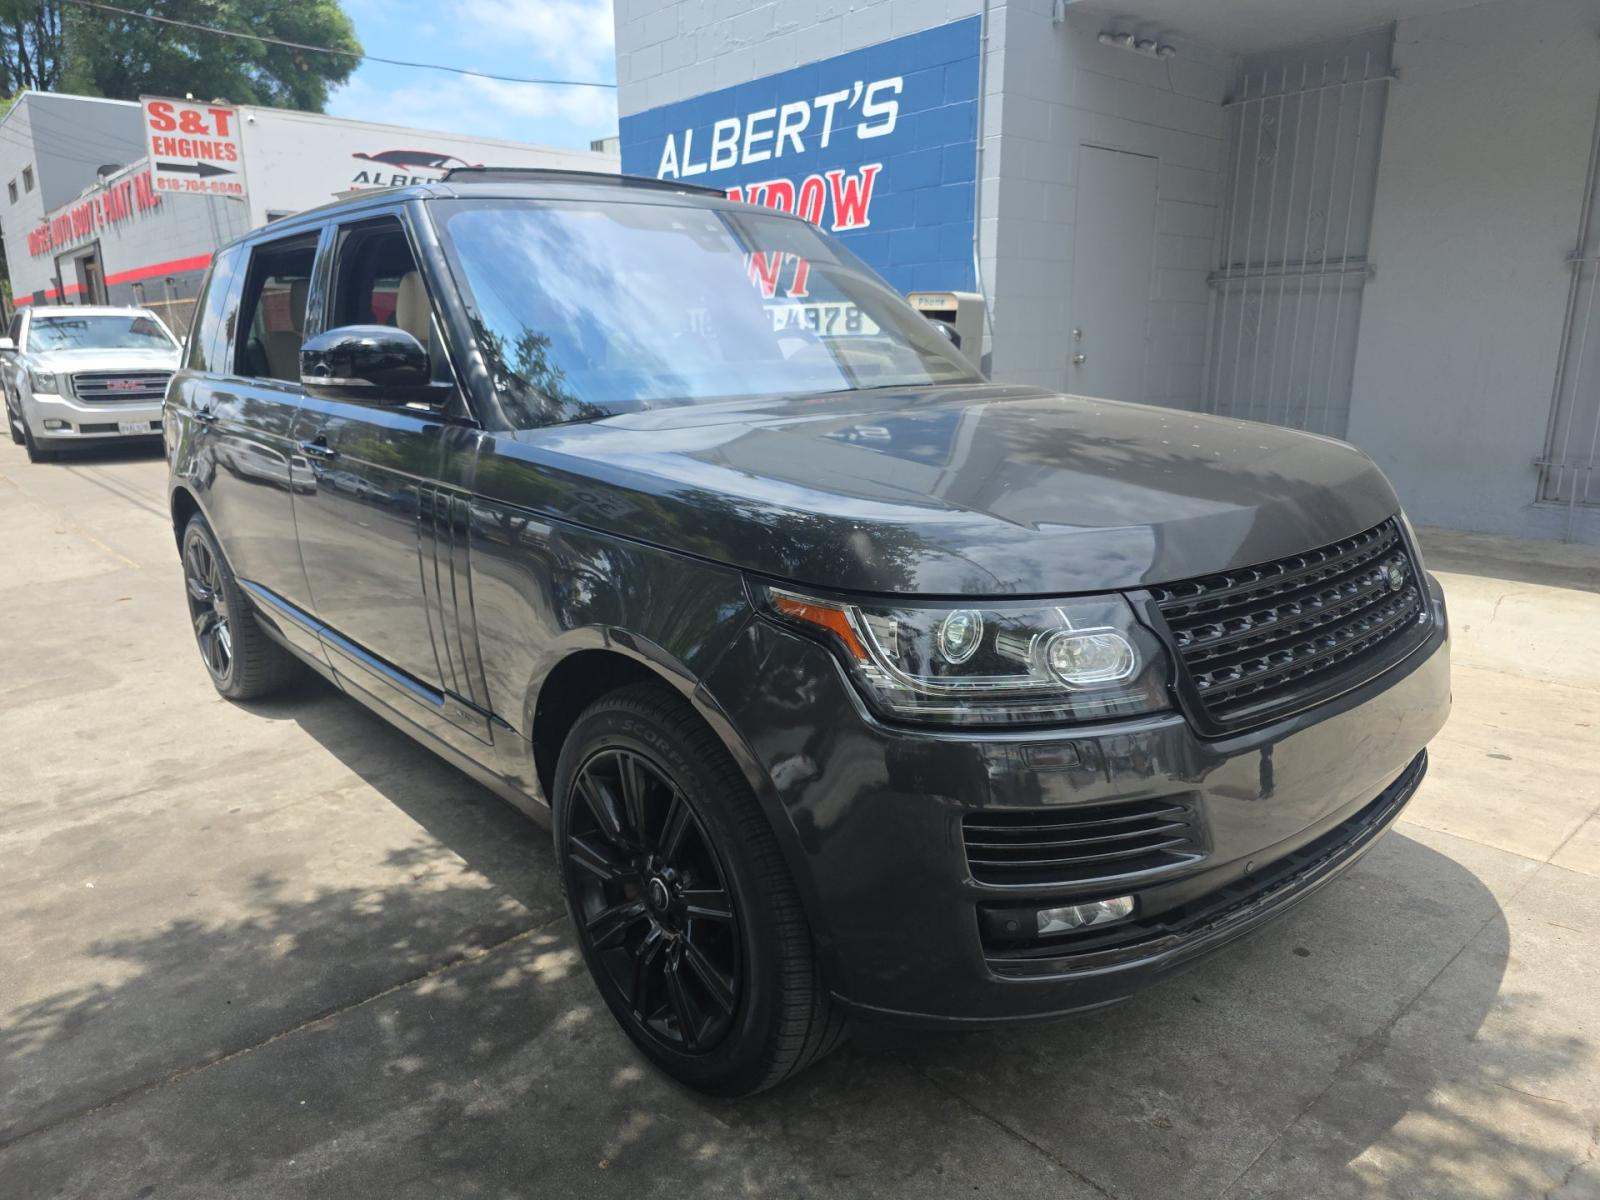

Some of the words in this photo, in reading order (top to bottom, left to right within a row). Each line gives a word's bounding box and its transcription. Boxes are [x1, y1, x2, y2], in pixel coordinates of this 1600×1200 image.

[148, 101, 233, 137] S&T
[658, 77, 903, 179] ALBERT'S
[152, 136, 237, 162] ENGINES
